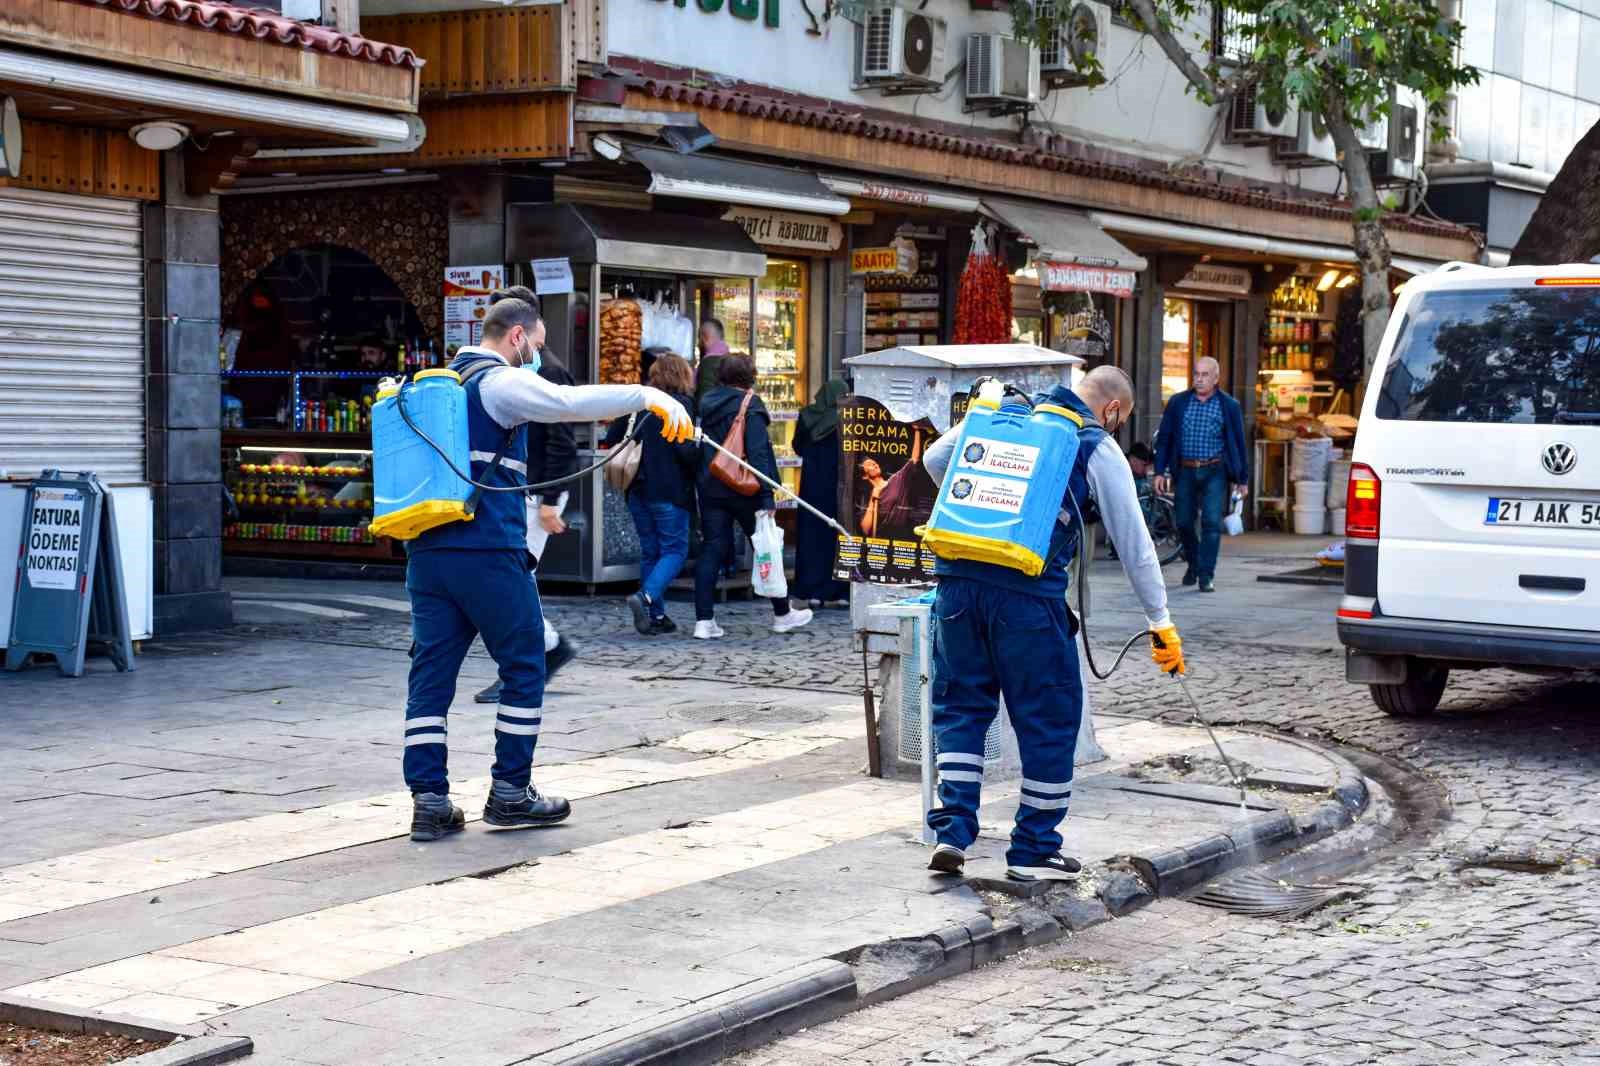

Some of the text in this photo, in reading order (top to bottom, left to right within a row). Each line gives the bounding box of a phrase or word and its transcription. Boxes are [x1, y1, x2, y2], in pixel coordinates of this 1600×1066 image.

[843, 423, 909, 439] KOCAMA
[843, 440, 908, 456] BENZİYOR
[33, 508, 81, 527] FATURA
[1499, 502, 1521, 521] 21
[1534, 503, 1570, 524] AAK
[31, 528, 80, 552] ÖDEME
[28, 555, 78, 572] NOKTASI
